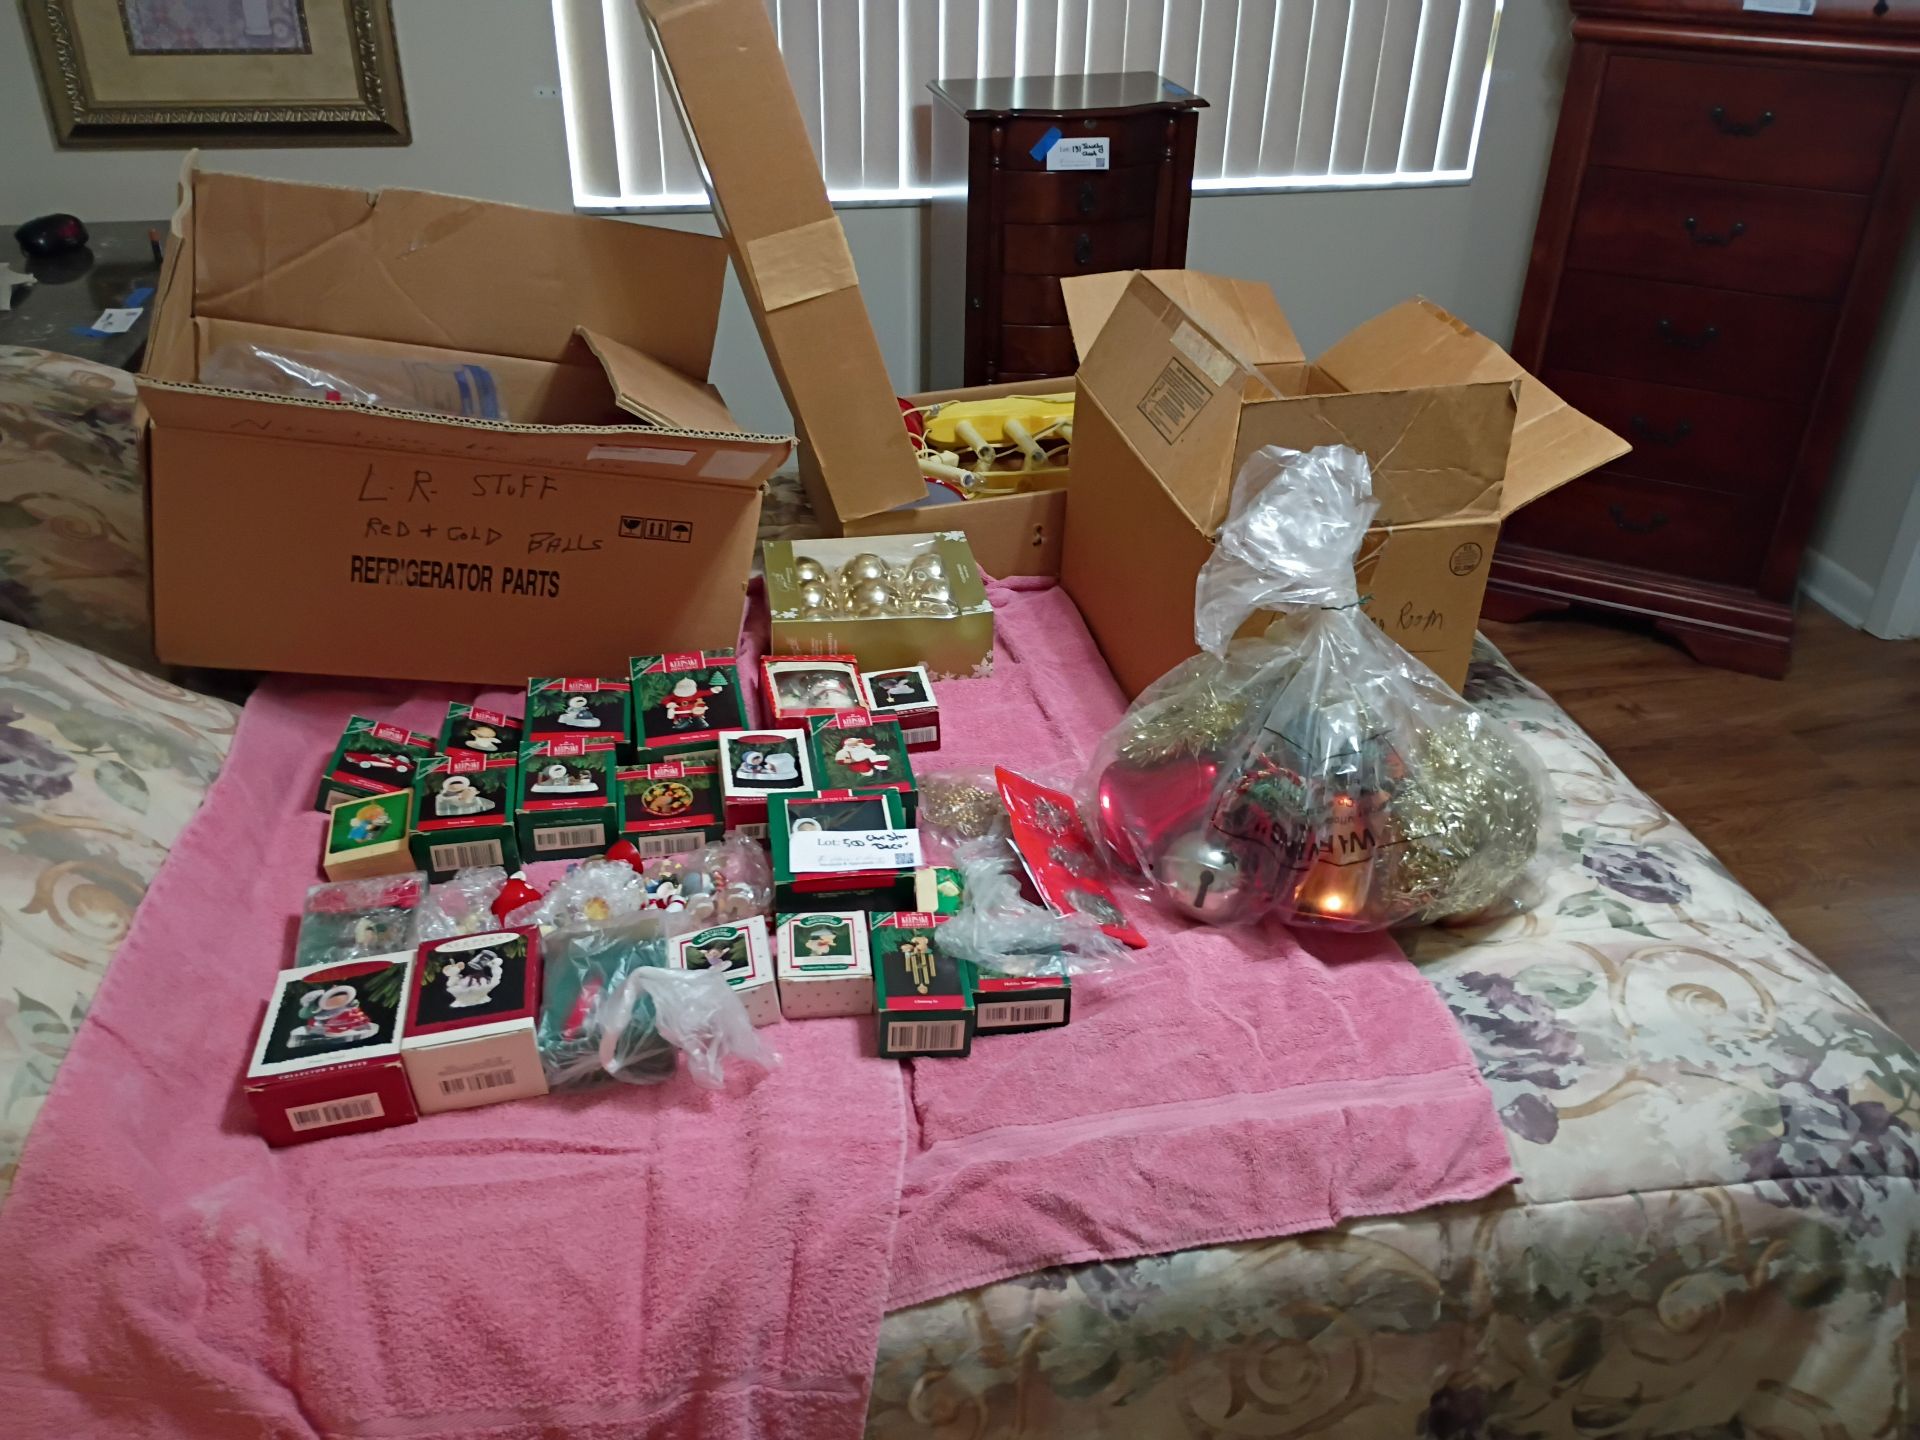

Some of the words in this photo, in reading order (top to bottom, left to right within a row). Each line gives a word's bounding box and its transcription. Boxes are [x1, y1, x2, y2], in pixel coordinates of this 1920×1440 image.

[350, 554, 493, 593] REFRIGERATOR
[501, 566, 560, 598] PARTS
[842, 838, 865, 847] 500
